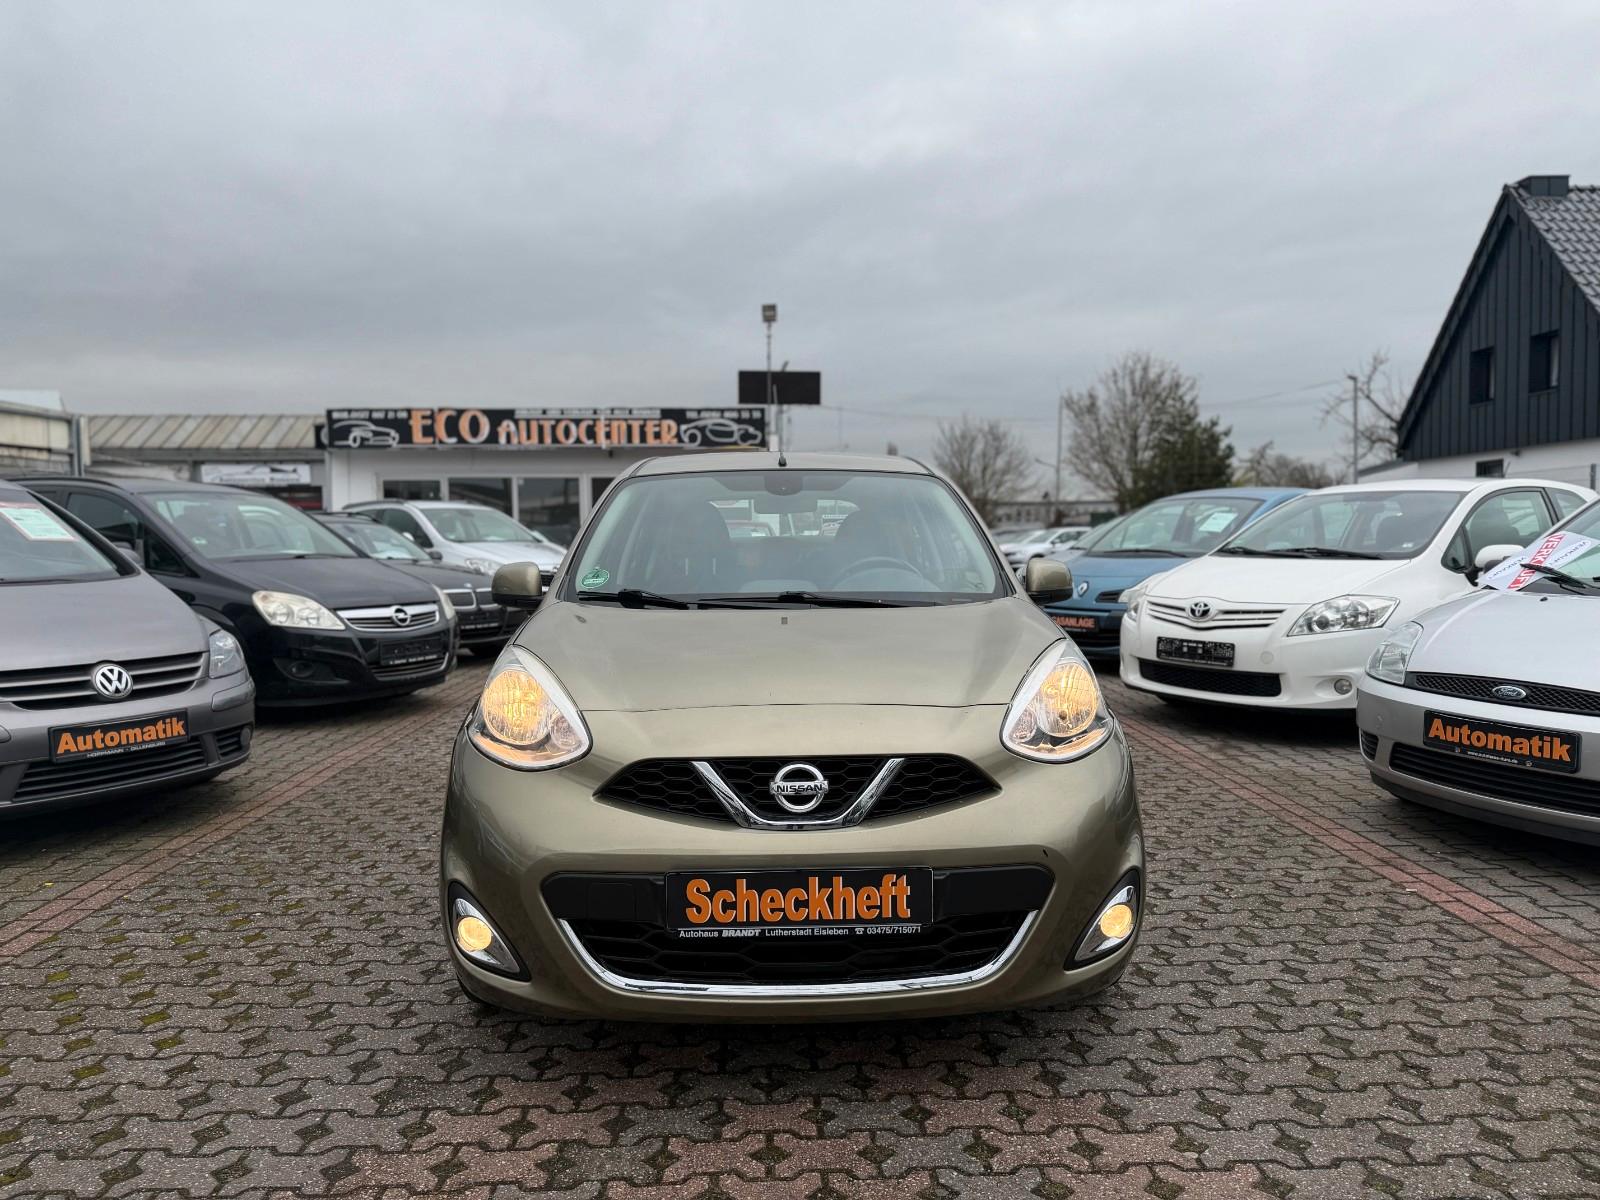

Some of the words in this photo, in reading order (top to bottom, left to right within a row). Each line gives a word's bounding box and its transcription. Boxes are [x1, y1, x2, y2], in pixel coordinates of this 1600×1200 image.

[409, 409, 490, 445] ECO
[497, 418, 679, 445] AUTOCENTER
[1508, 534, 1564, 589] VERKUFT
[57, 716, 186, 755] Automatik
[1428, 718, 1571, 762] Automatik
[776, 784, 822, 793] NISSAN
[685, 874, 911, 924] Scheckheft
[679, 930, 719, 938] Autohaus
[721, 929, 761, 937] BRANDT
[765, 928, 812, 937] Lutherstadt
[814, 927, 849, 936] Eisleben
[866, 926, 921, 935] 03475/715071
